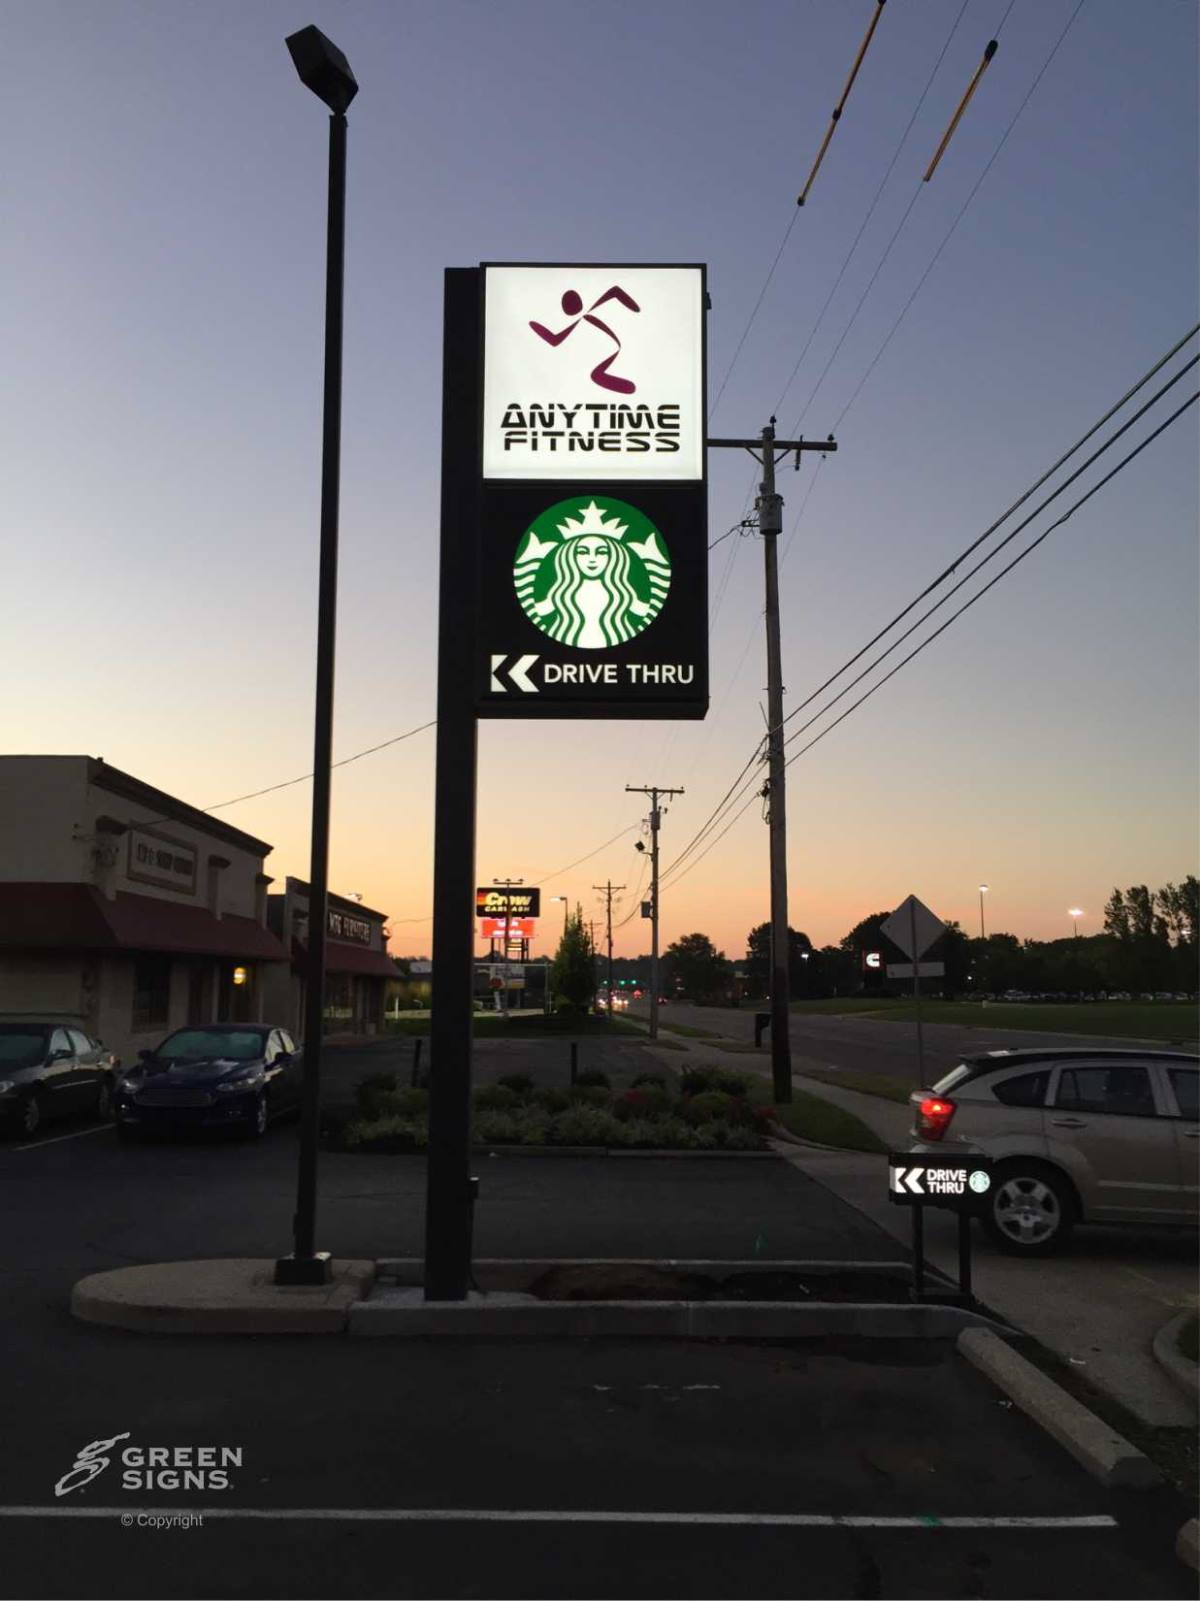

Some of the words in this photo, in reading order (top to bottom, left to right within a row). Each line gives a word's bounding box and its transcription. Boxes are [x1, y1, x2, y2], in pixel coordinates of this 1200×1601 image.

[500, 403, 680, 429] ANYTIME
[504, 431, 680, 452] FITNESS
[544, 664, 618, 683] DRIVE
[626, 664, 694, 684] THRU
[926, 1168, 967, 1182] DRIVE
[927, 1181, 964, 1194] THRU
